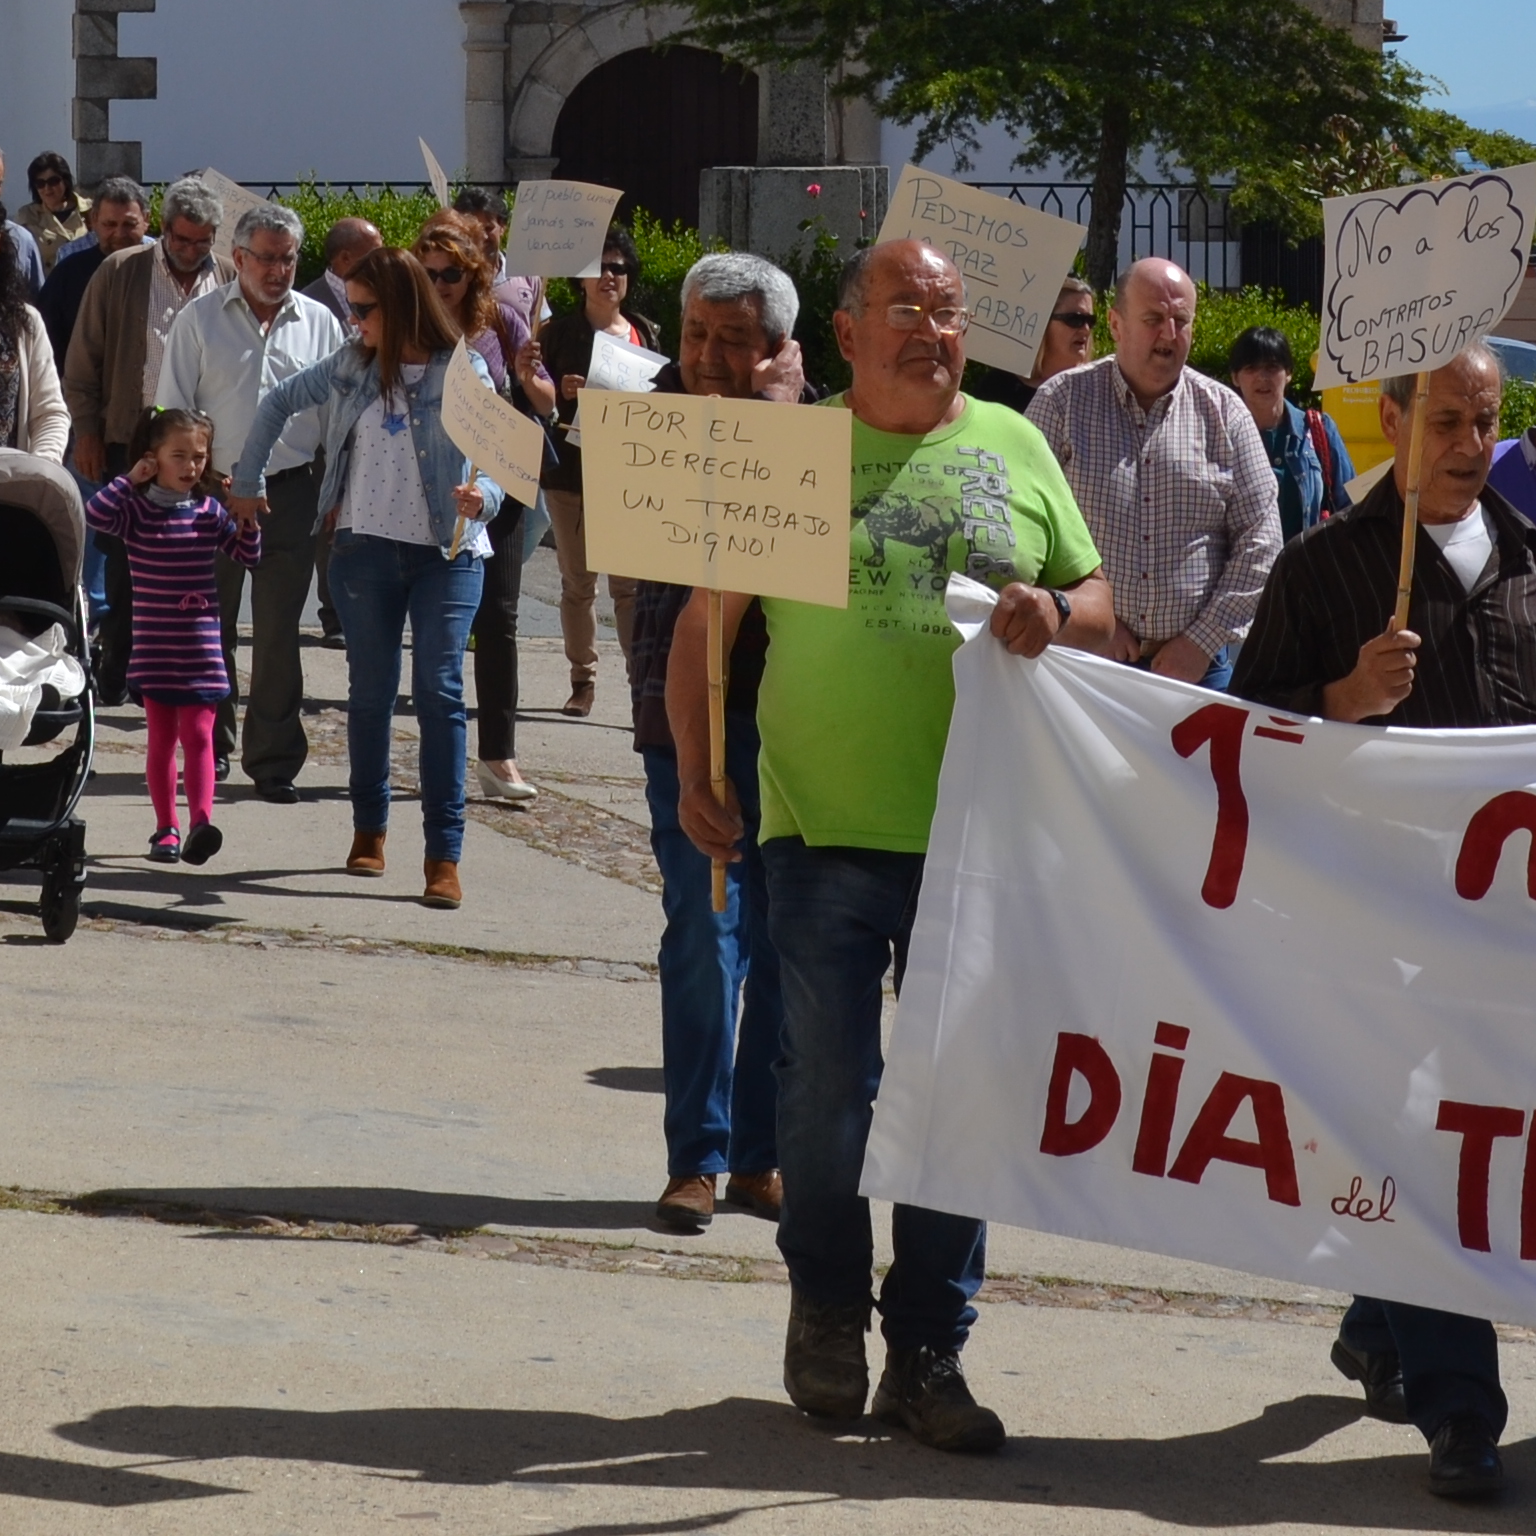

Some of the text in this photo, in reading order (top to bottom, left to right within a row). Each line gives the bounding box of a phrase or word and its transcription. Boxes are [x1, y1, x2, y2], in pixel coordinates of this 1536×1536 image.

[542, 186, 582, 212] pueblo
[907, 177, 1028, 248] PEDIMOS
[1348, 195, 1504, 277] No a los
[945, 240, 1037, 293] PAZ Y
[974, 295, 1039, 338] ABRA
[1337, 289, 1457, 342] CONTRATOS
[1361, 307, 1495, 378] BASURA
[453, 404, 490, 452] SOMOS
[473, 387, 518, 430] SOMOS
[709, 419, 754, 443] EL
[621, 441, 818, 488] DERECHO A
[622, 489, 831, 537] UN TRABAJO
[957, 446, 1016, 547] FREE
[849, 568, 947, 591] EW YO
[1330, 1175, 1397, 1223] del
